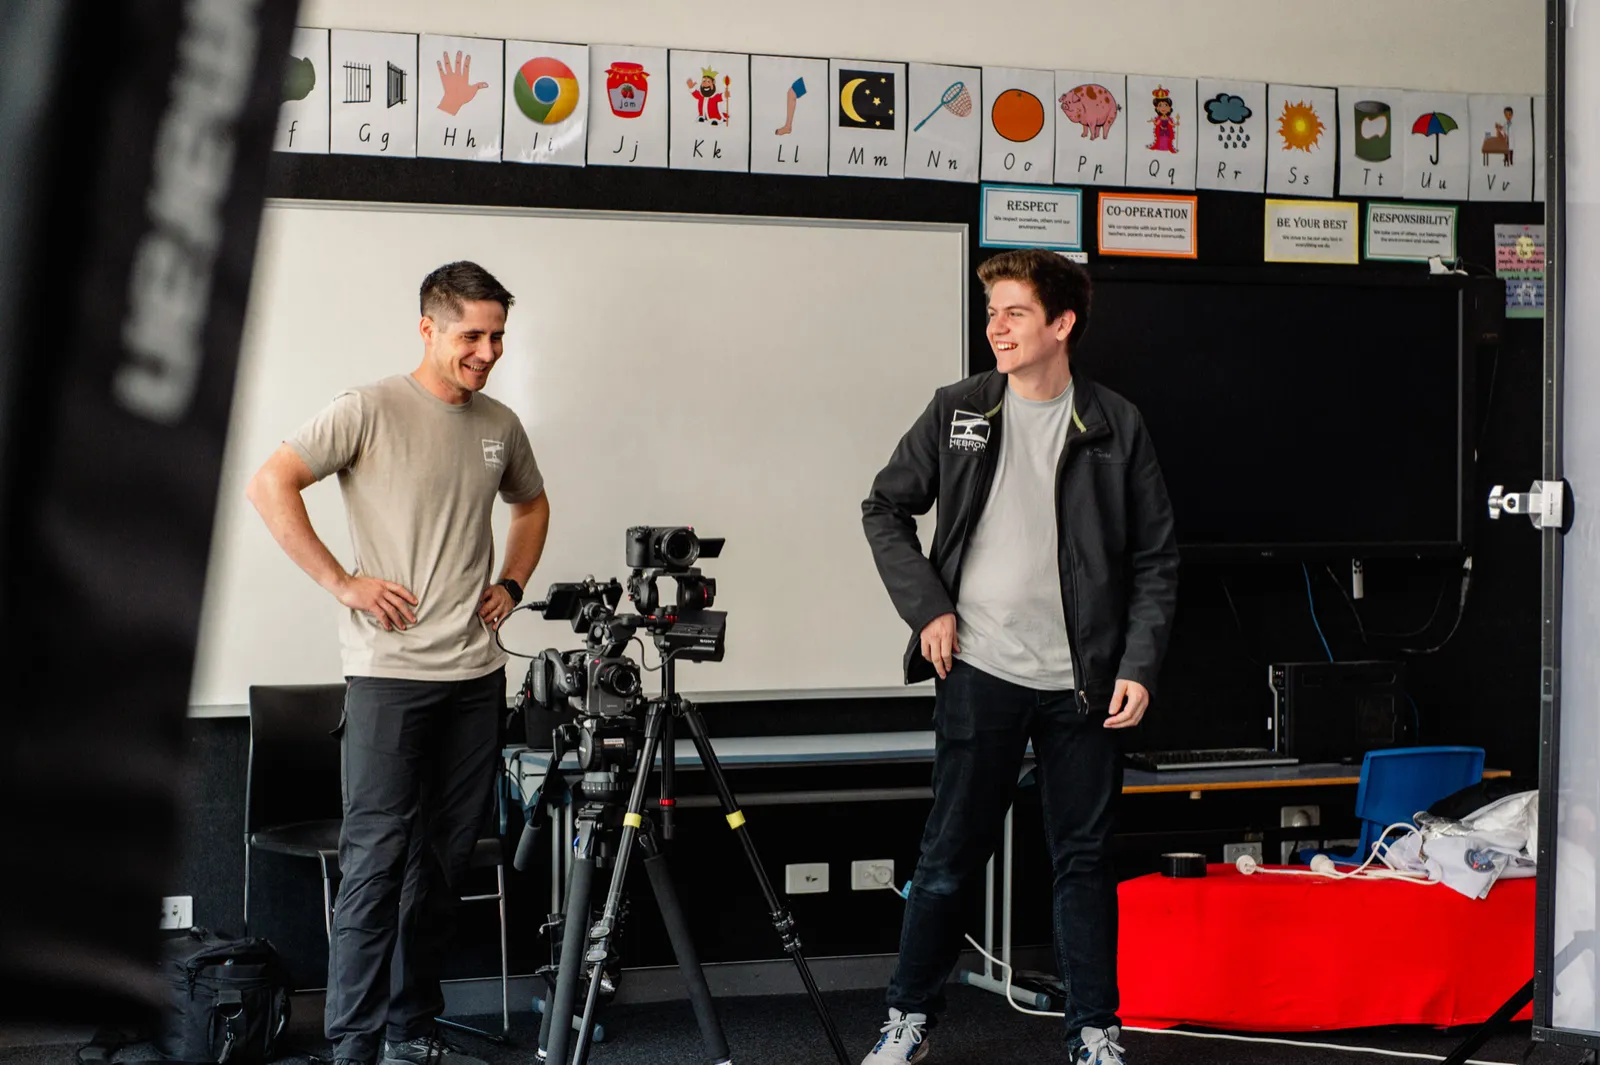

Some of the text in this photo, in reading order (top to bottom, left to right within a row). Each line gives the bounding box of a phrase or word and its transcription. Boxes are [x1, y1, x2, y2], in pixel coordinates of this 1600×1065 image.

[619, 99, 637, 110] jam
[1006, 200, 1059, 213] RESPECT
[1106, 205, 1188, 219] CO-OPERATION
[1276, 216, 1348, 230] BE YOUR BEST
[1372, 212, 1451, 226] RESPONSIBILITY
